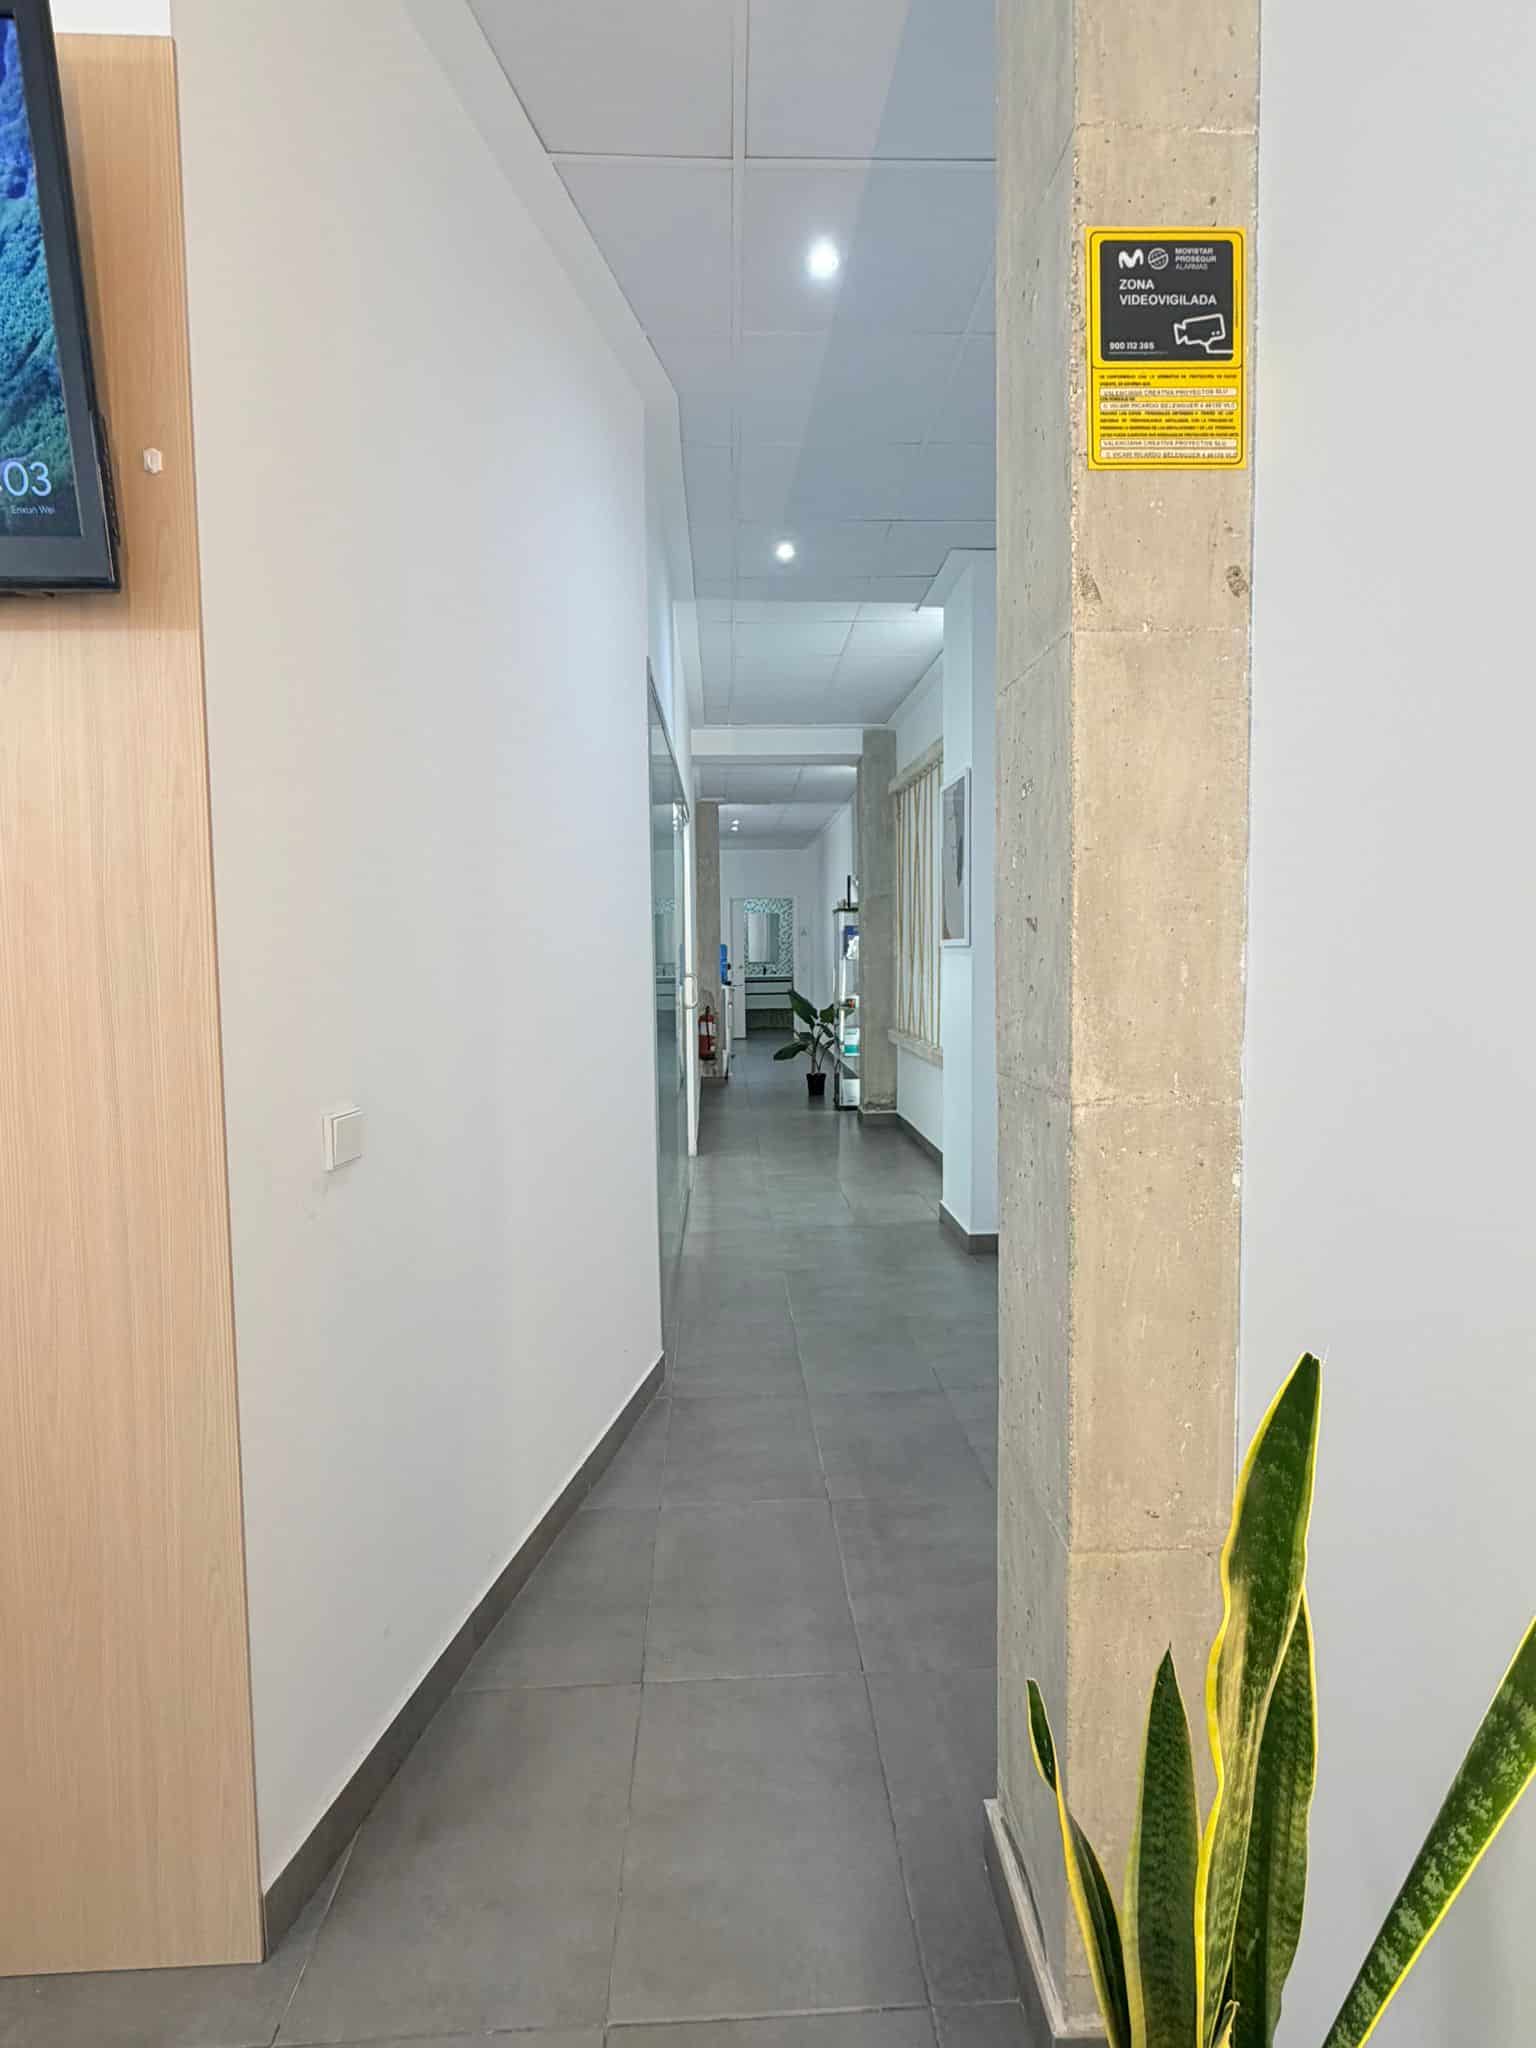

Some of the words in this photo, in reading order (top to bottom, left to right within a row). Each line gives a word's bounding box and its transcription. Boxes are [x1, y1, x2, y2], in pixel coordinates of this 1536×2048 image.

[1175, 255, 1217, 263] PROSEGUR
[1119, 279, 1155, 290] ZONA
[1119, 294, 1217, 306] VIDEOVIGILADA
